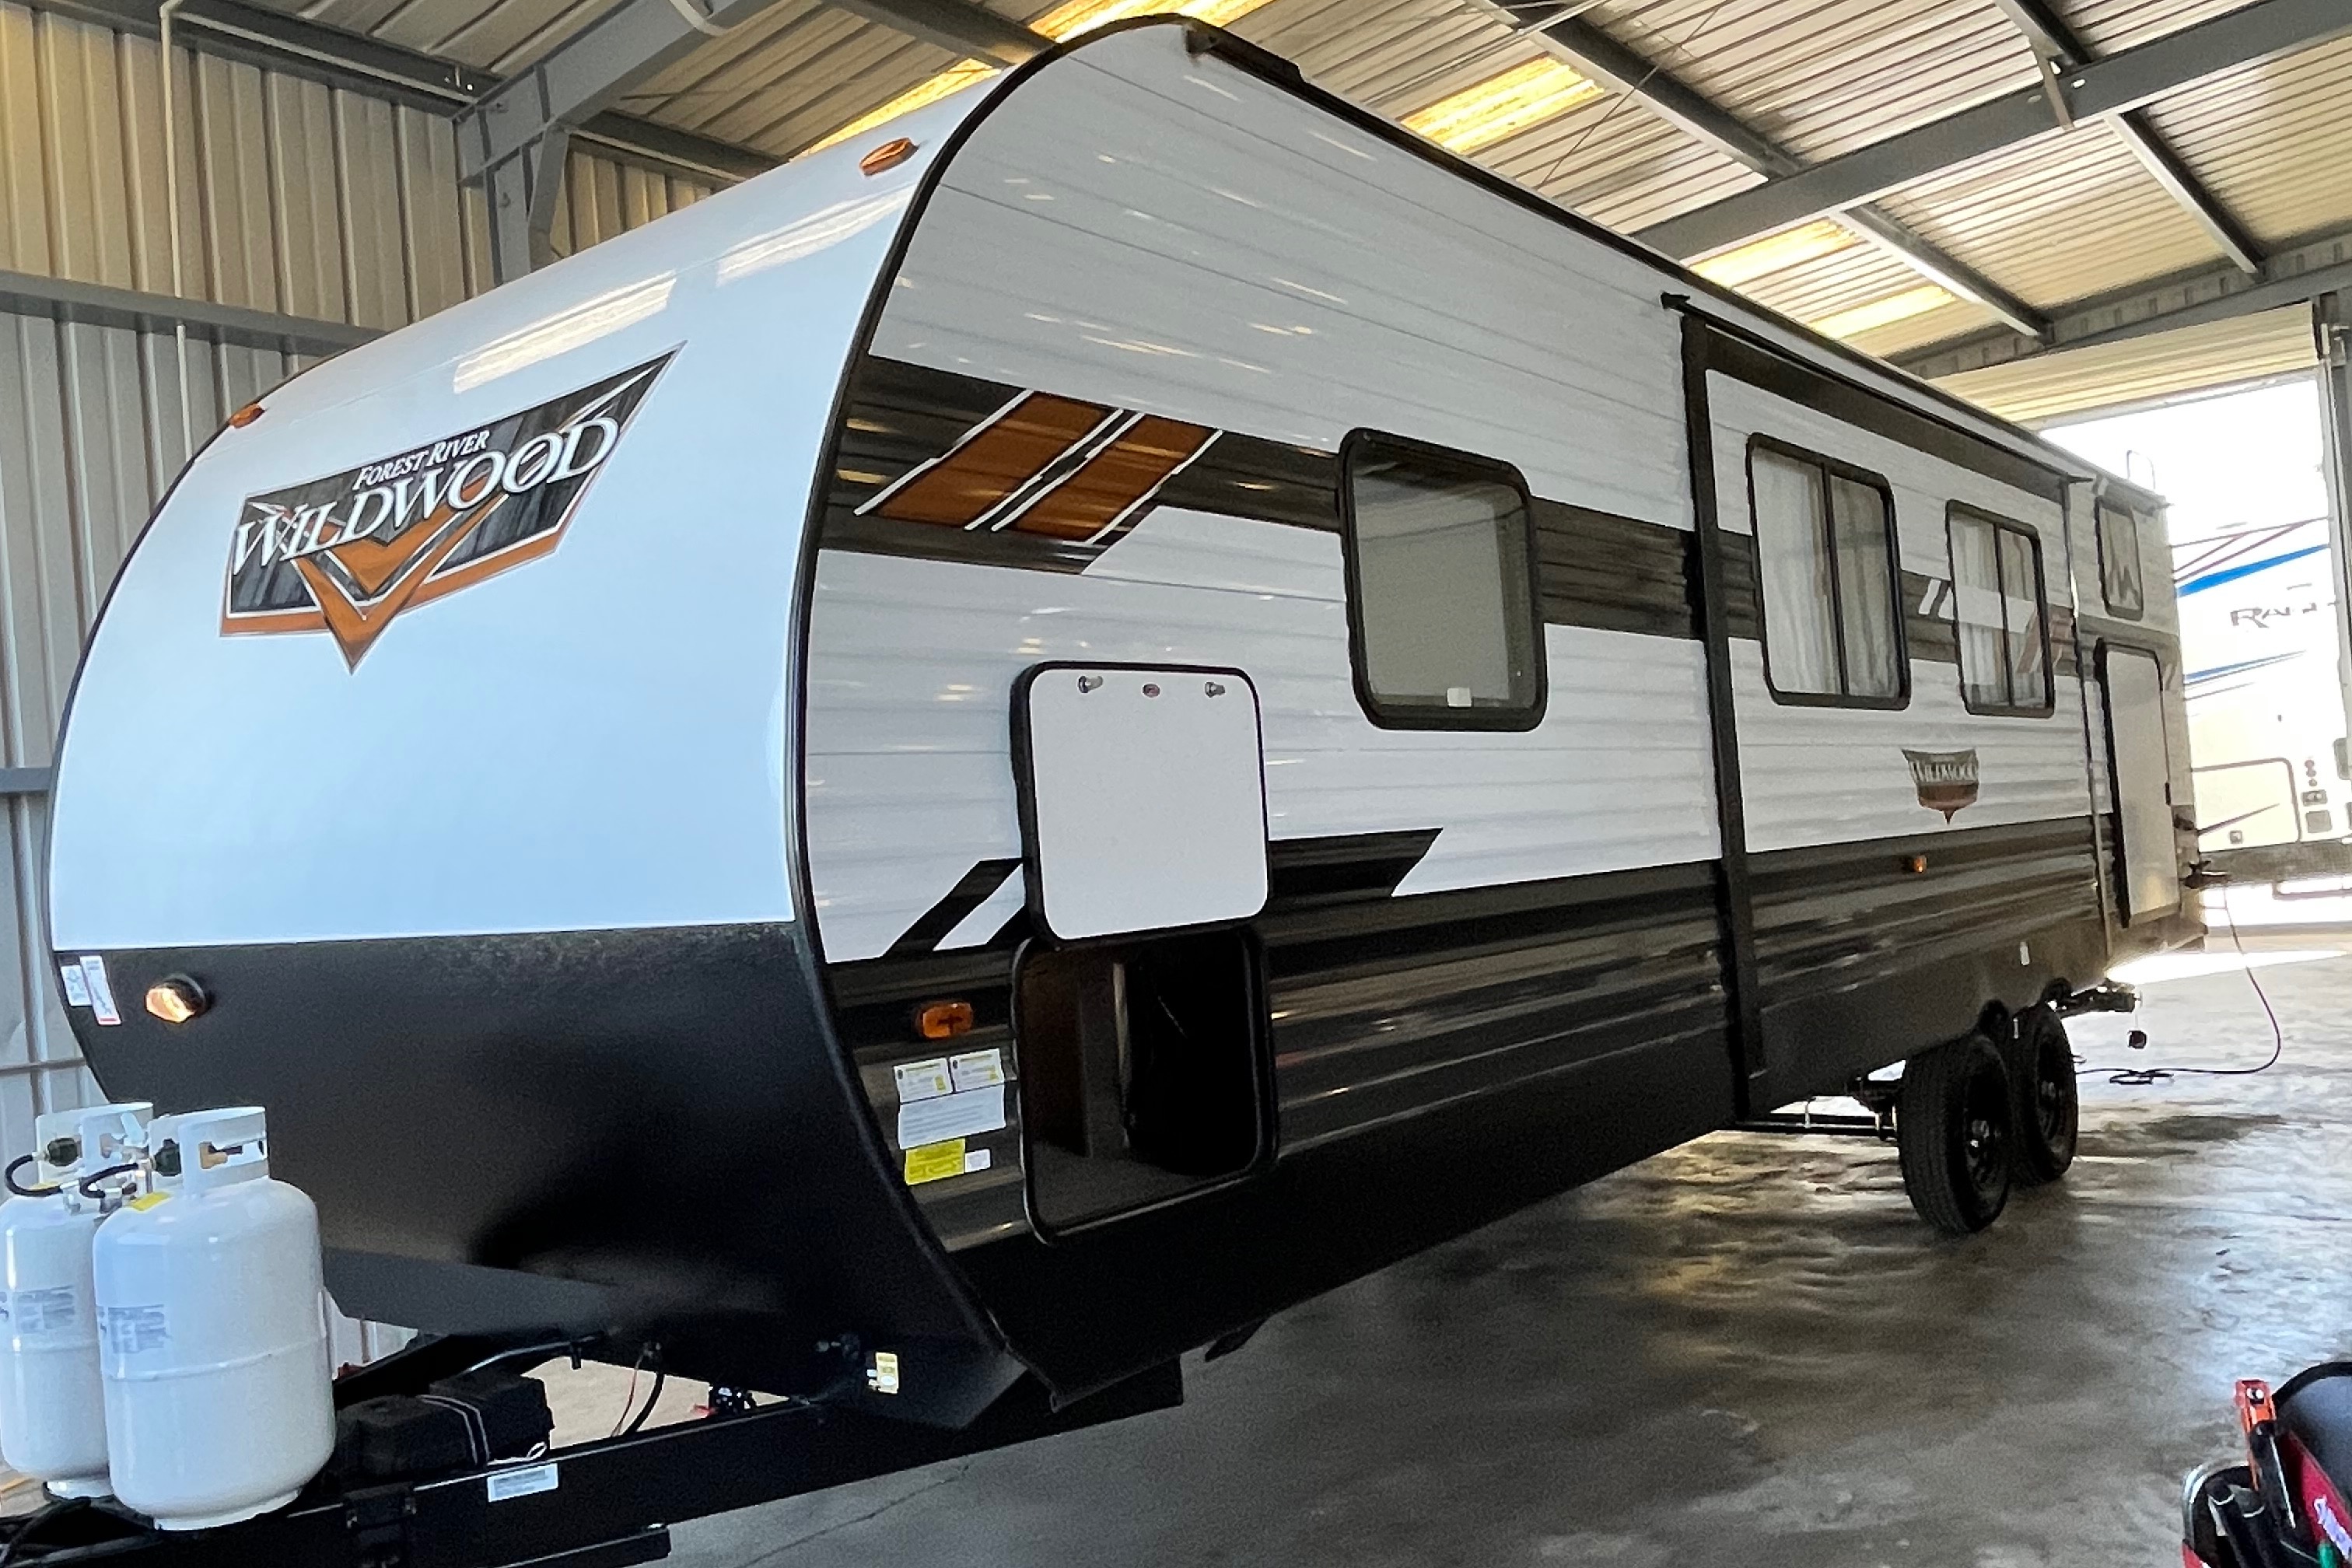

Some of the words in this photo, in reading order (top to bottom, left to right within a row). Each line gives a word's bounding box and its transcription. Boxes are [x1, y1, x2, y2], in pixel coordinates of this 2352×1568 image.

[234, 417, 620, 576] WILDWOOD
[352, 450, 429, 491] FOREST
[425, 430, 491, 467] RIVER
